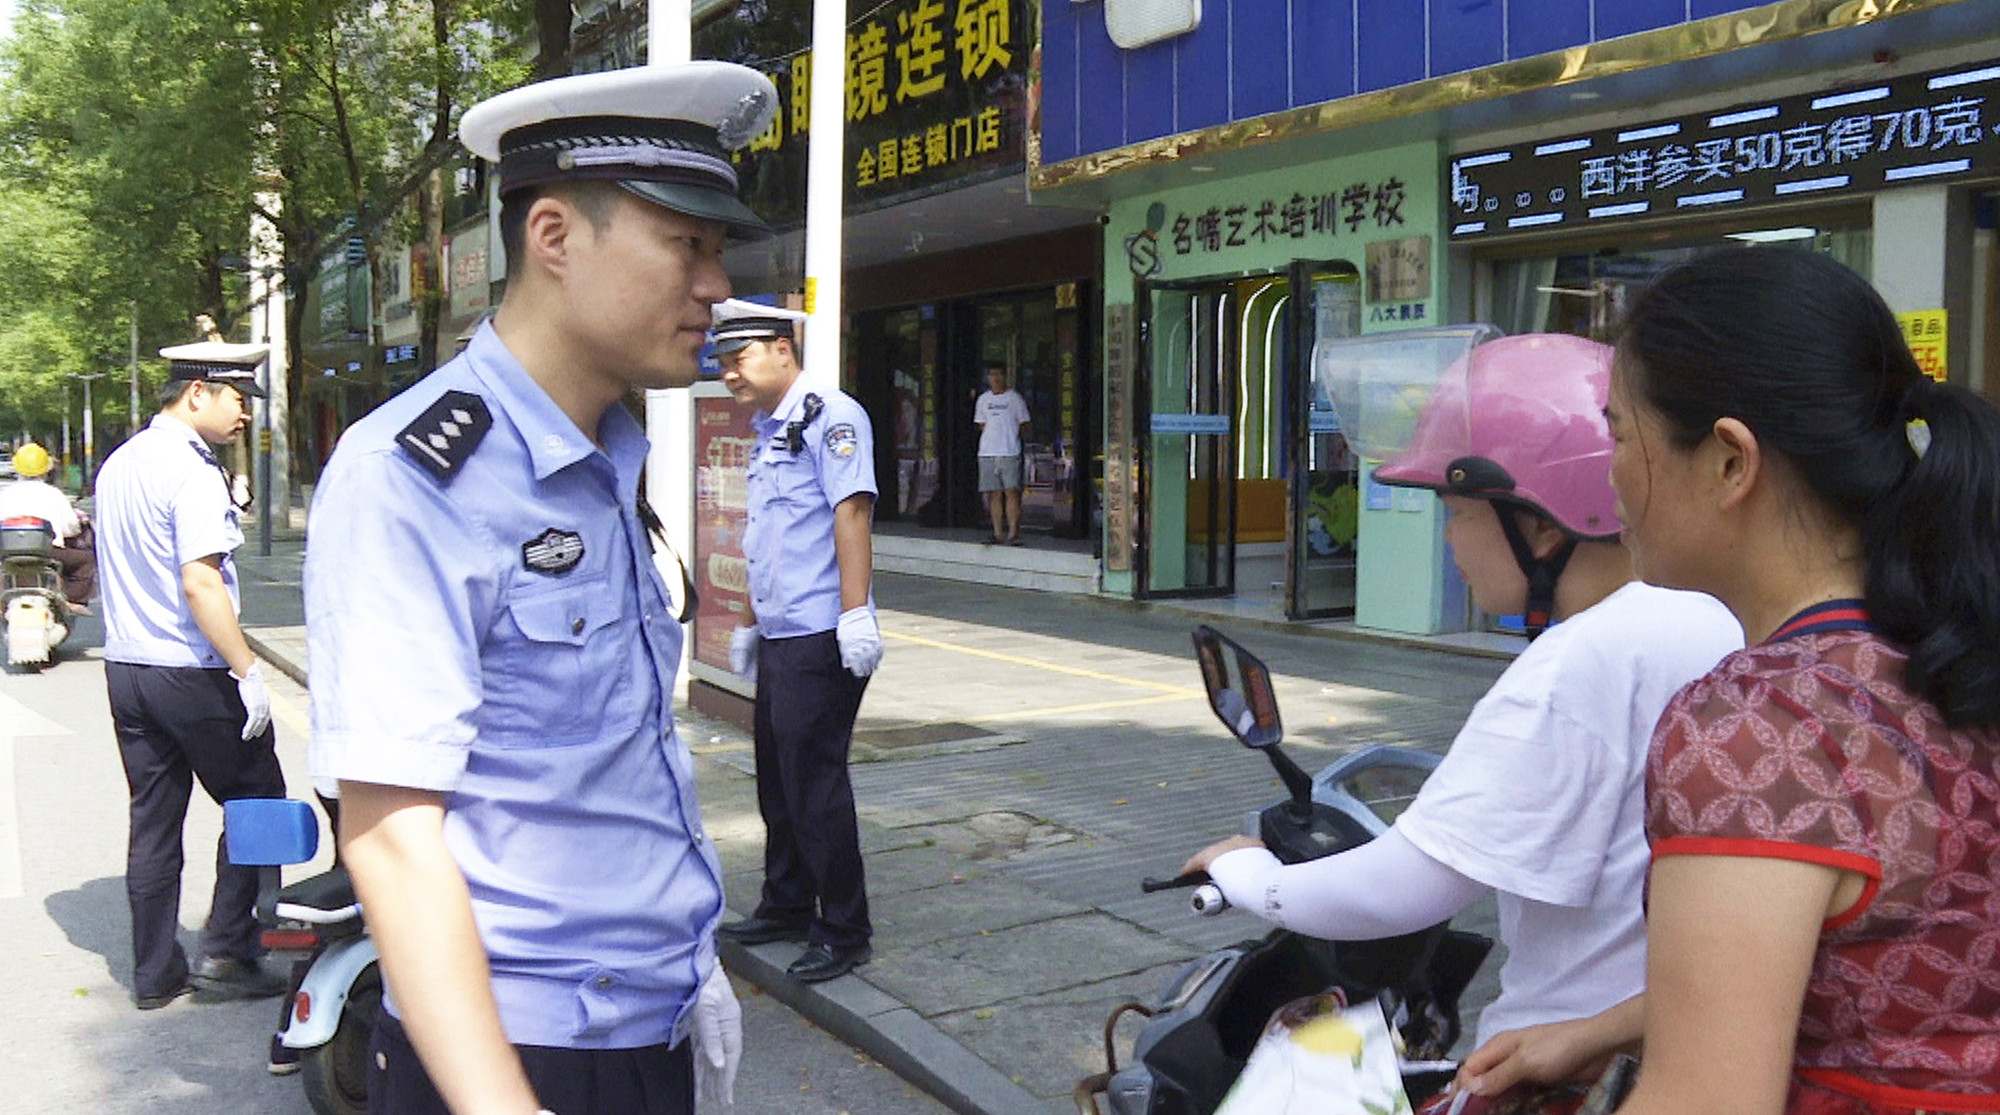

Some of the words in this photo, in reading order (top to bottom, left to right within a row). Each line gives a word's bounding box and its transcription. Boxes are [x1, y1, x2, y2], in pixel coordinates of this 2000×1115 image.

[732, 0, 1012, 163] 眼镜连锁
[856, 104, 1002, 188] 全国连锁门店
[1580, 96, 1987, 199] 西洋参买50克得70克
[1171, 176, 1406, 255] 名嘴艺术培训学校
